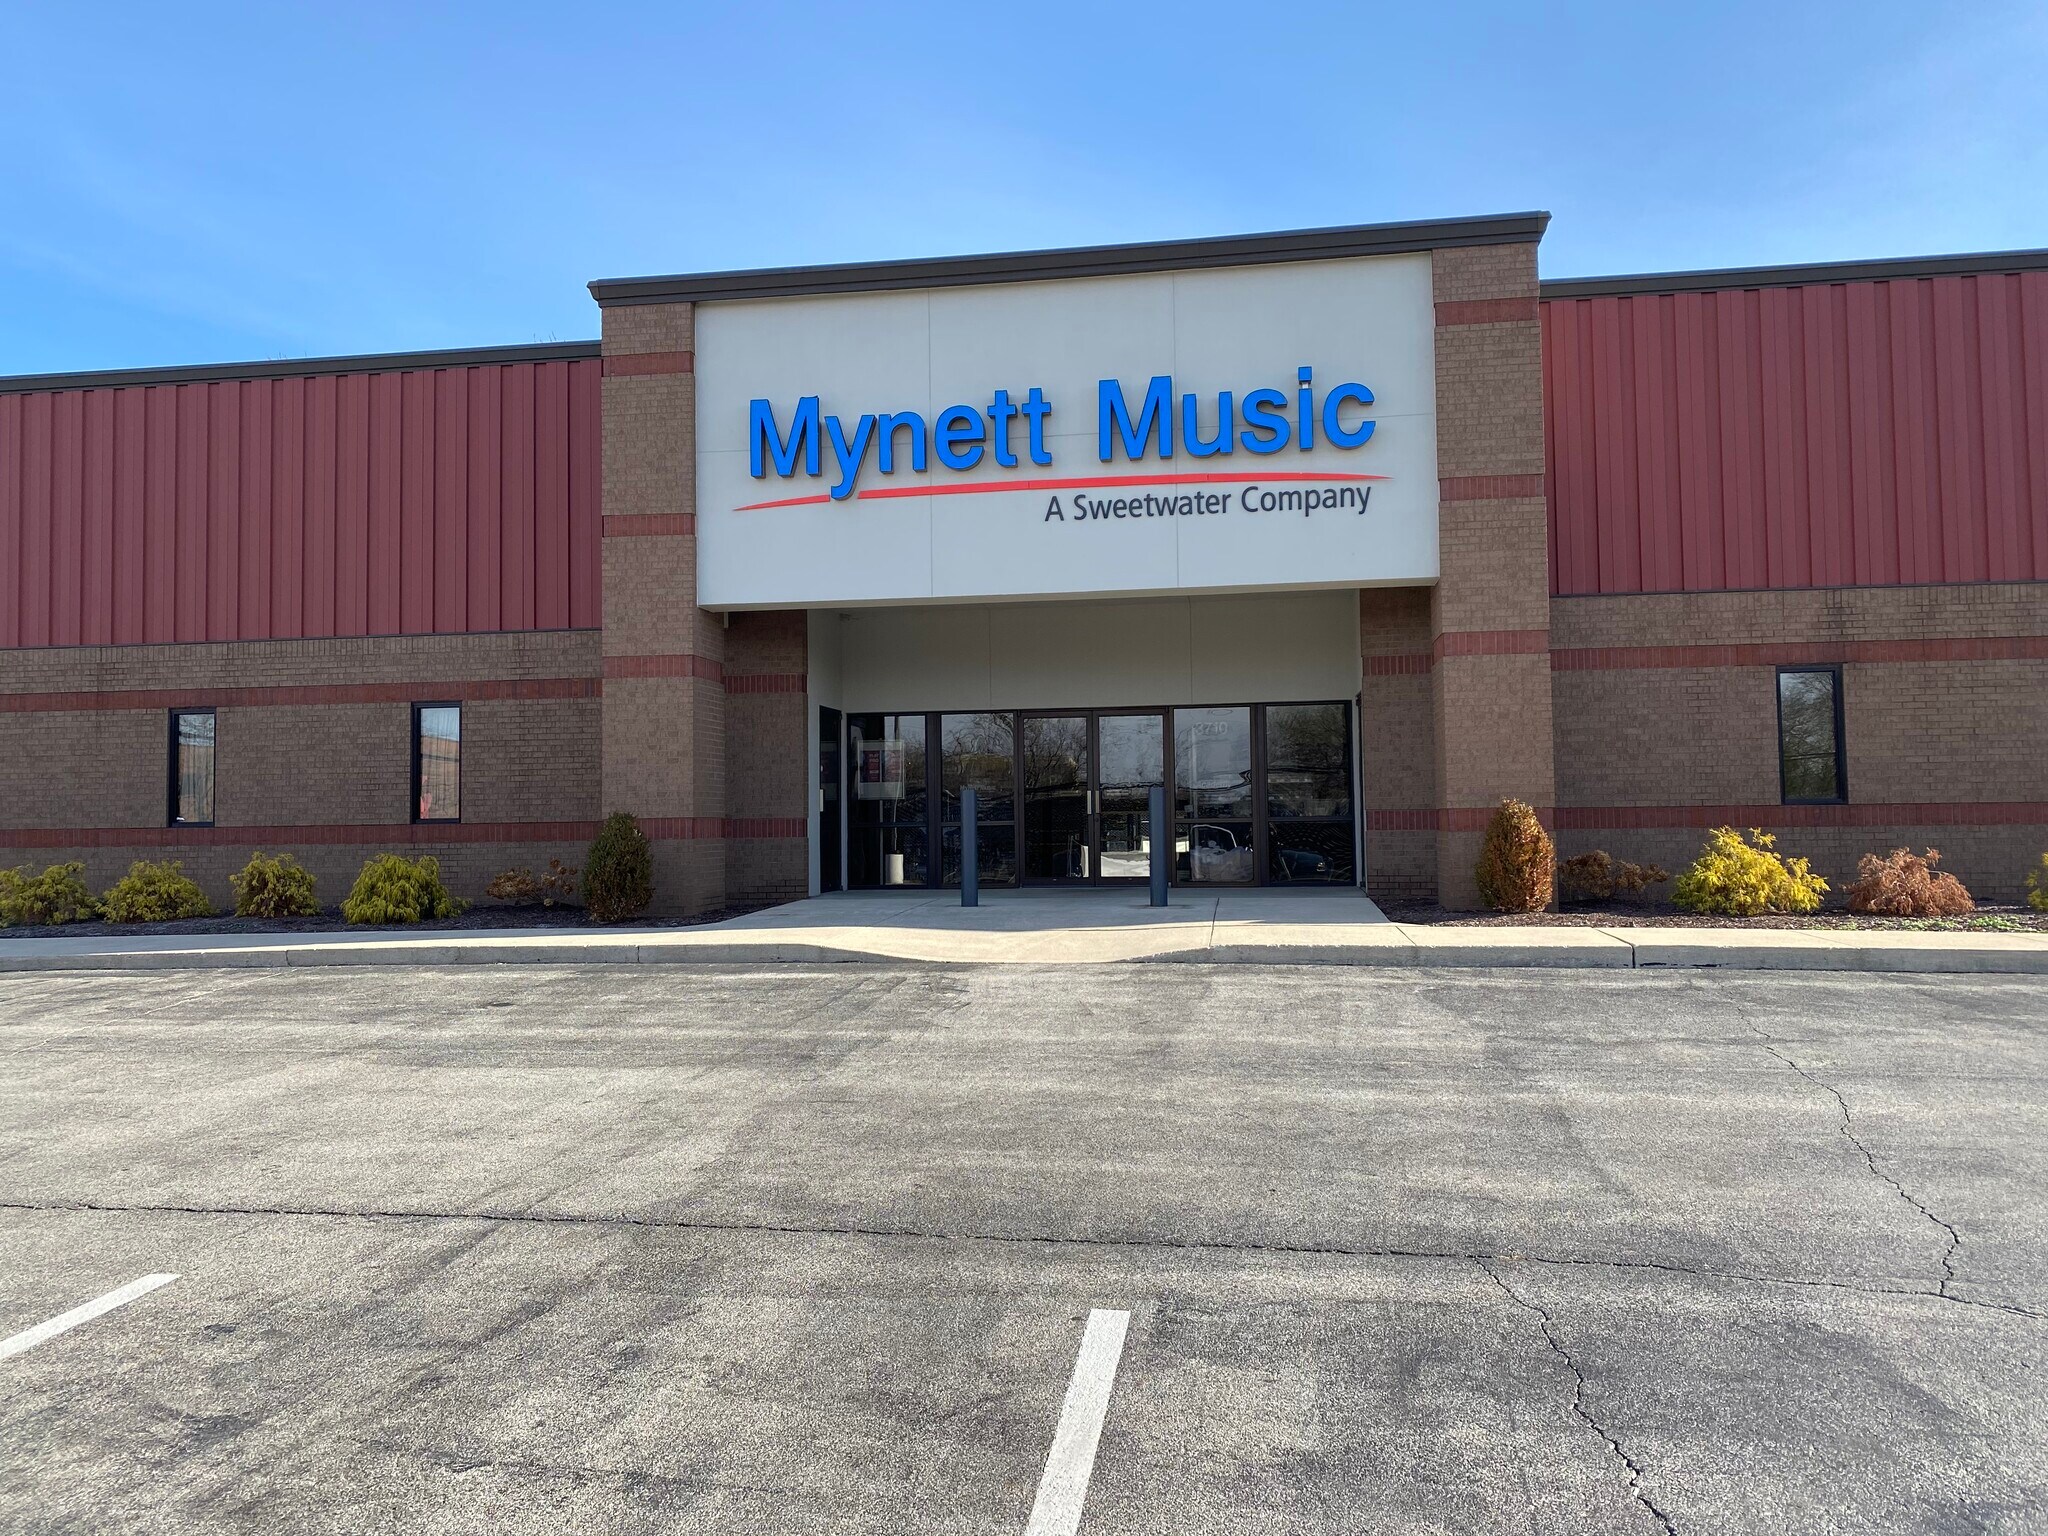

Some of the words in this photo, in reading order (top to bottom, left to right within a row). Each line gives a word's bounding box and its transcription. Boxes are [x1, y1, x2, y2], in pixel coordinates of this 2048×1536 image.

[750, 387, 1053, 500] Mynett
[1098, 366, 1377, 463] Music
[1044, 496, 1065, 522] A
[1073, 490, 1231, 521] Sweetwater
[1241, 485, 1372, 517] Company
